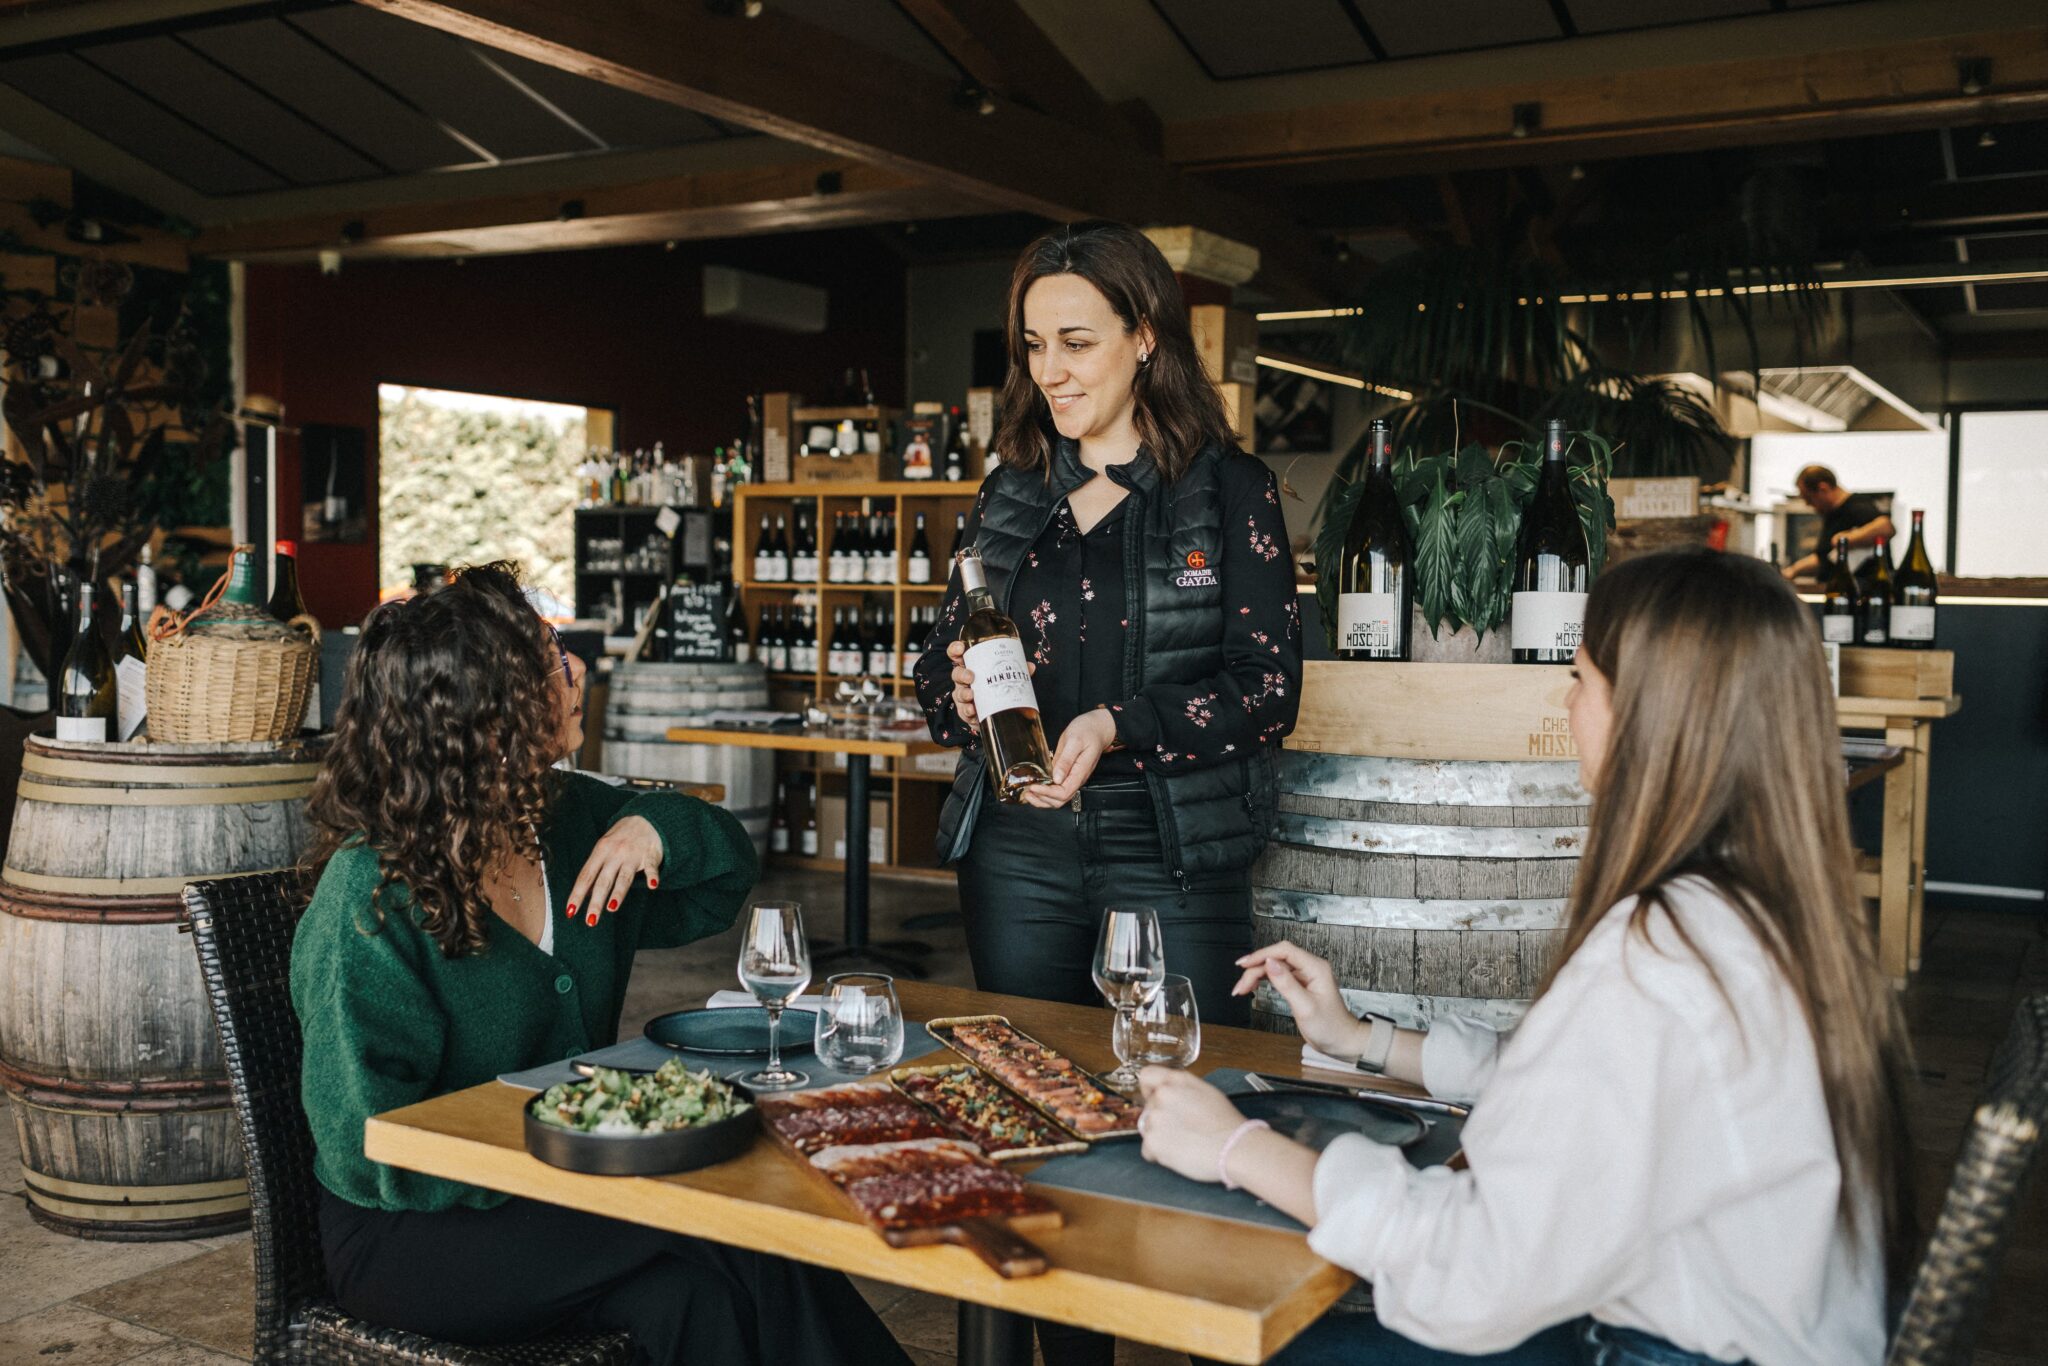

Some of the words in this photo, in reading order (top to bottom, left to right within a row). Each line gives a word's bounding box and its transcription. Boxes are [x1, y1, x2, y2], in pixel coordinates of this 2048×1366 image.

[1183, 569, 1212, 577] DOMAINE
[1176, 576, 1218, 587] GAYDA
[1346, 633, 1389, 647] MOSCOU
[1542, 717, 1570, 733] CHE
